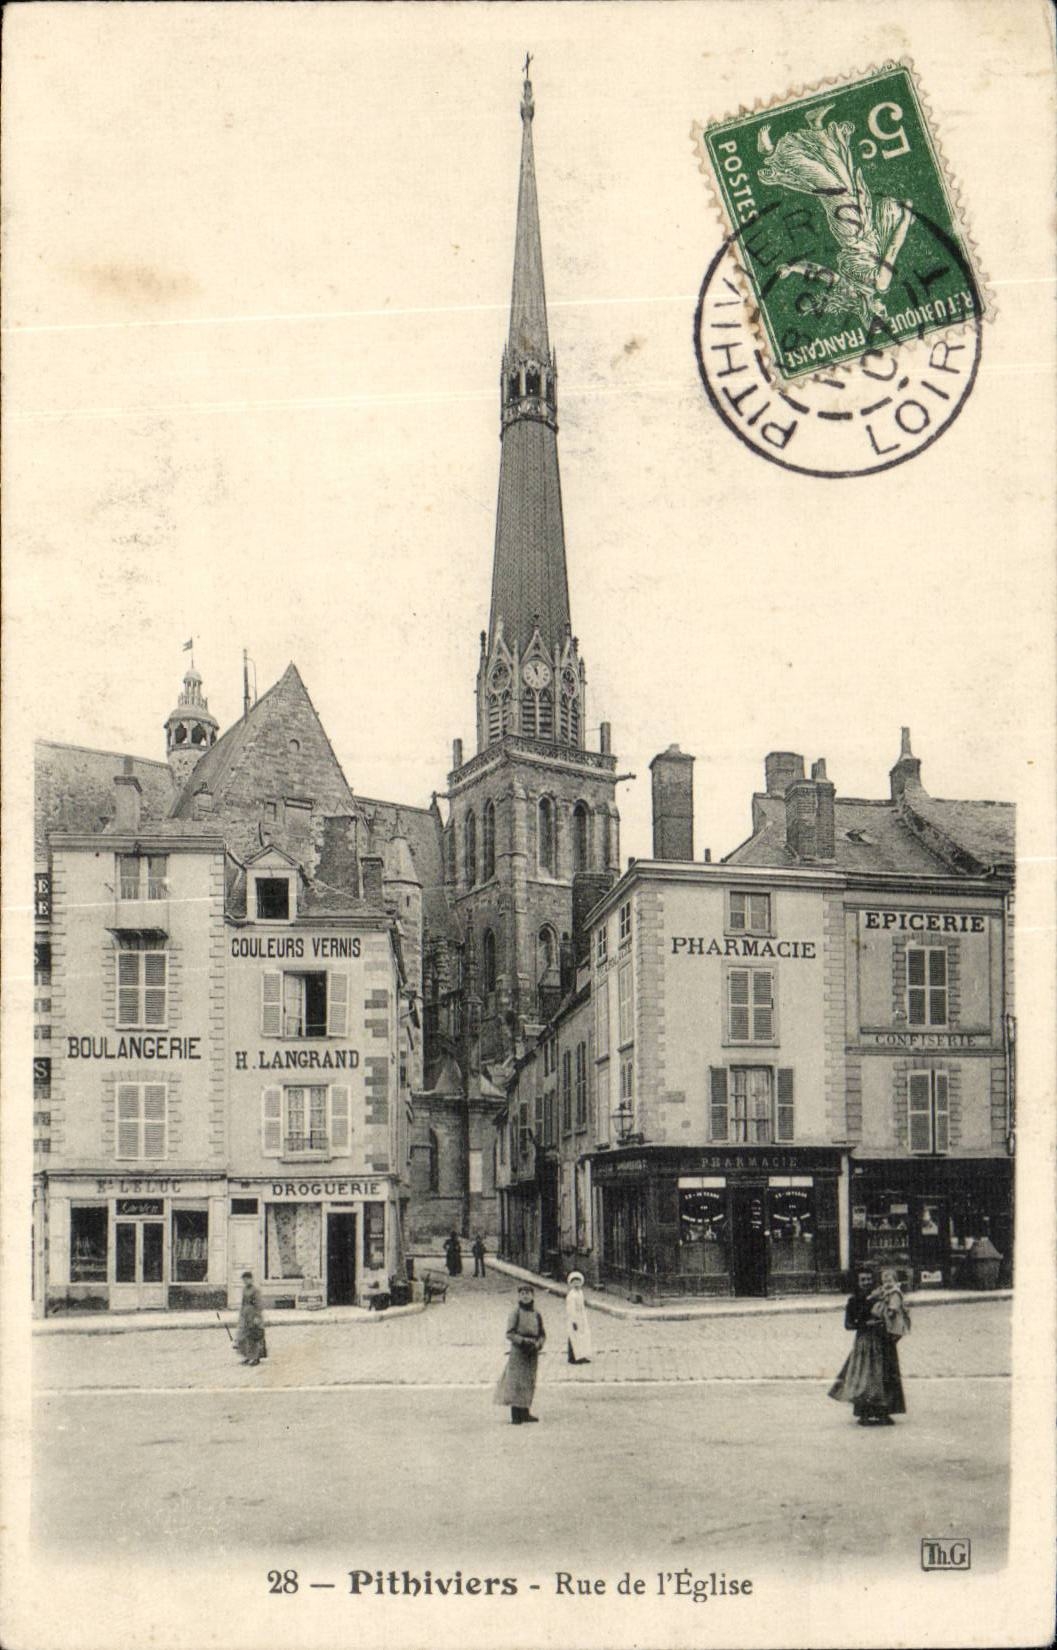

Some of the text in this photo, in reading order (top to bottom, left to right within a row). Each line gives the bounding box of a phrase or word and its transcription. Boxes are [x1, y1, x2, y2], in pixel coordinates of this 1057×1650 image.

[718, 140, 759, 224] POSTES
[710, 202, 866, 450] PITHIVIERS
[865, 912, 985, 933] EPICERIE
[231, 937, 361, 958] COULEURS VERNIS
[671, 936, 816, 960] PHARMACIE
[67, 1036, 201, 1060] BOULANGERIE
[875, 1033, 976, 1048] CONFISERIE
[259, 1050, 360, 1070] LANGRAND
[701, 1157, 798, 1169] PHARMACIE
[271, 1182, 381, 1197] DROGUERIE
